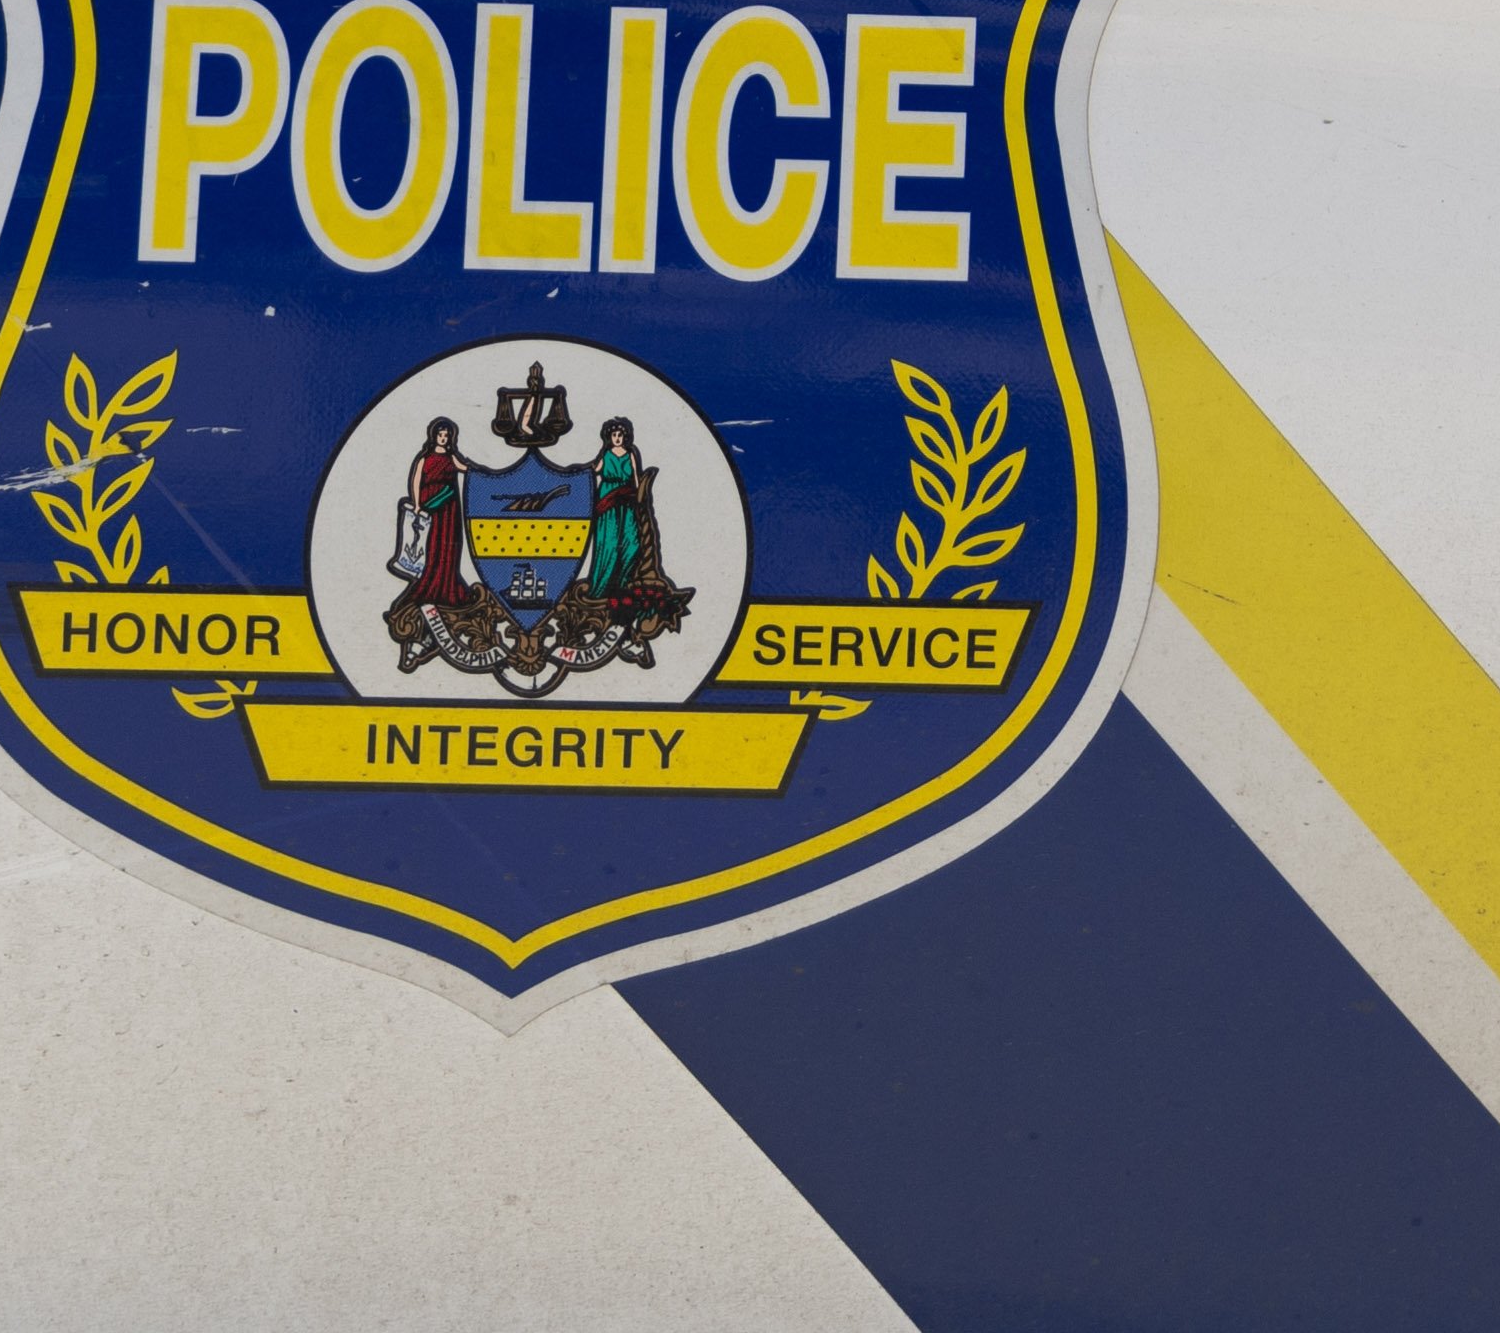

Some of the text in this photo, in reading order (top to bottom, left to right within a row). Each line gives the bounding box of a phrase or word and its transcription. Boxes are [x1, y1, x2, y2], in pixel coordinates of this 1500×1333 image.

[61, 611, 282, 657] HONOR
[425, 606, 502, 666] PHILADELPHIA
[752, 623, 999, 670] SERVICE
[366, 723, 685, 770] INTEGRITY
